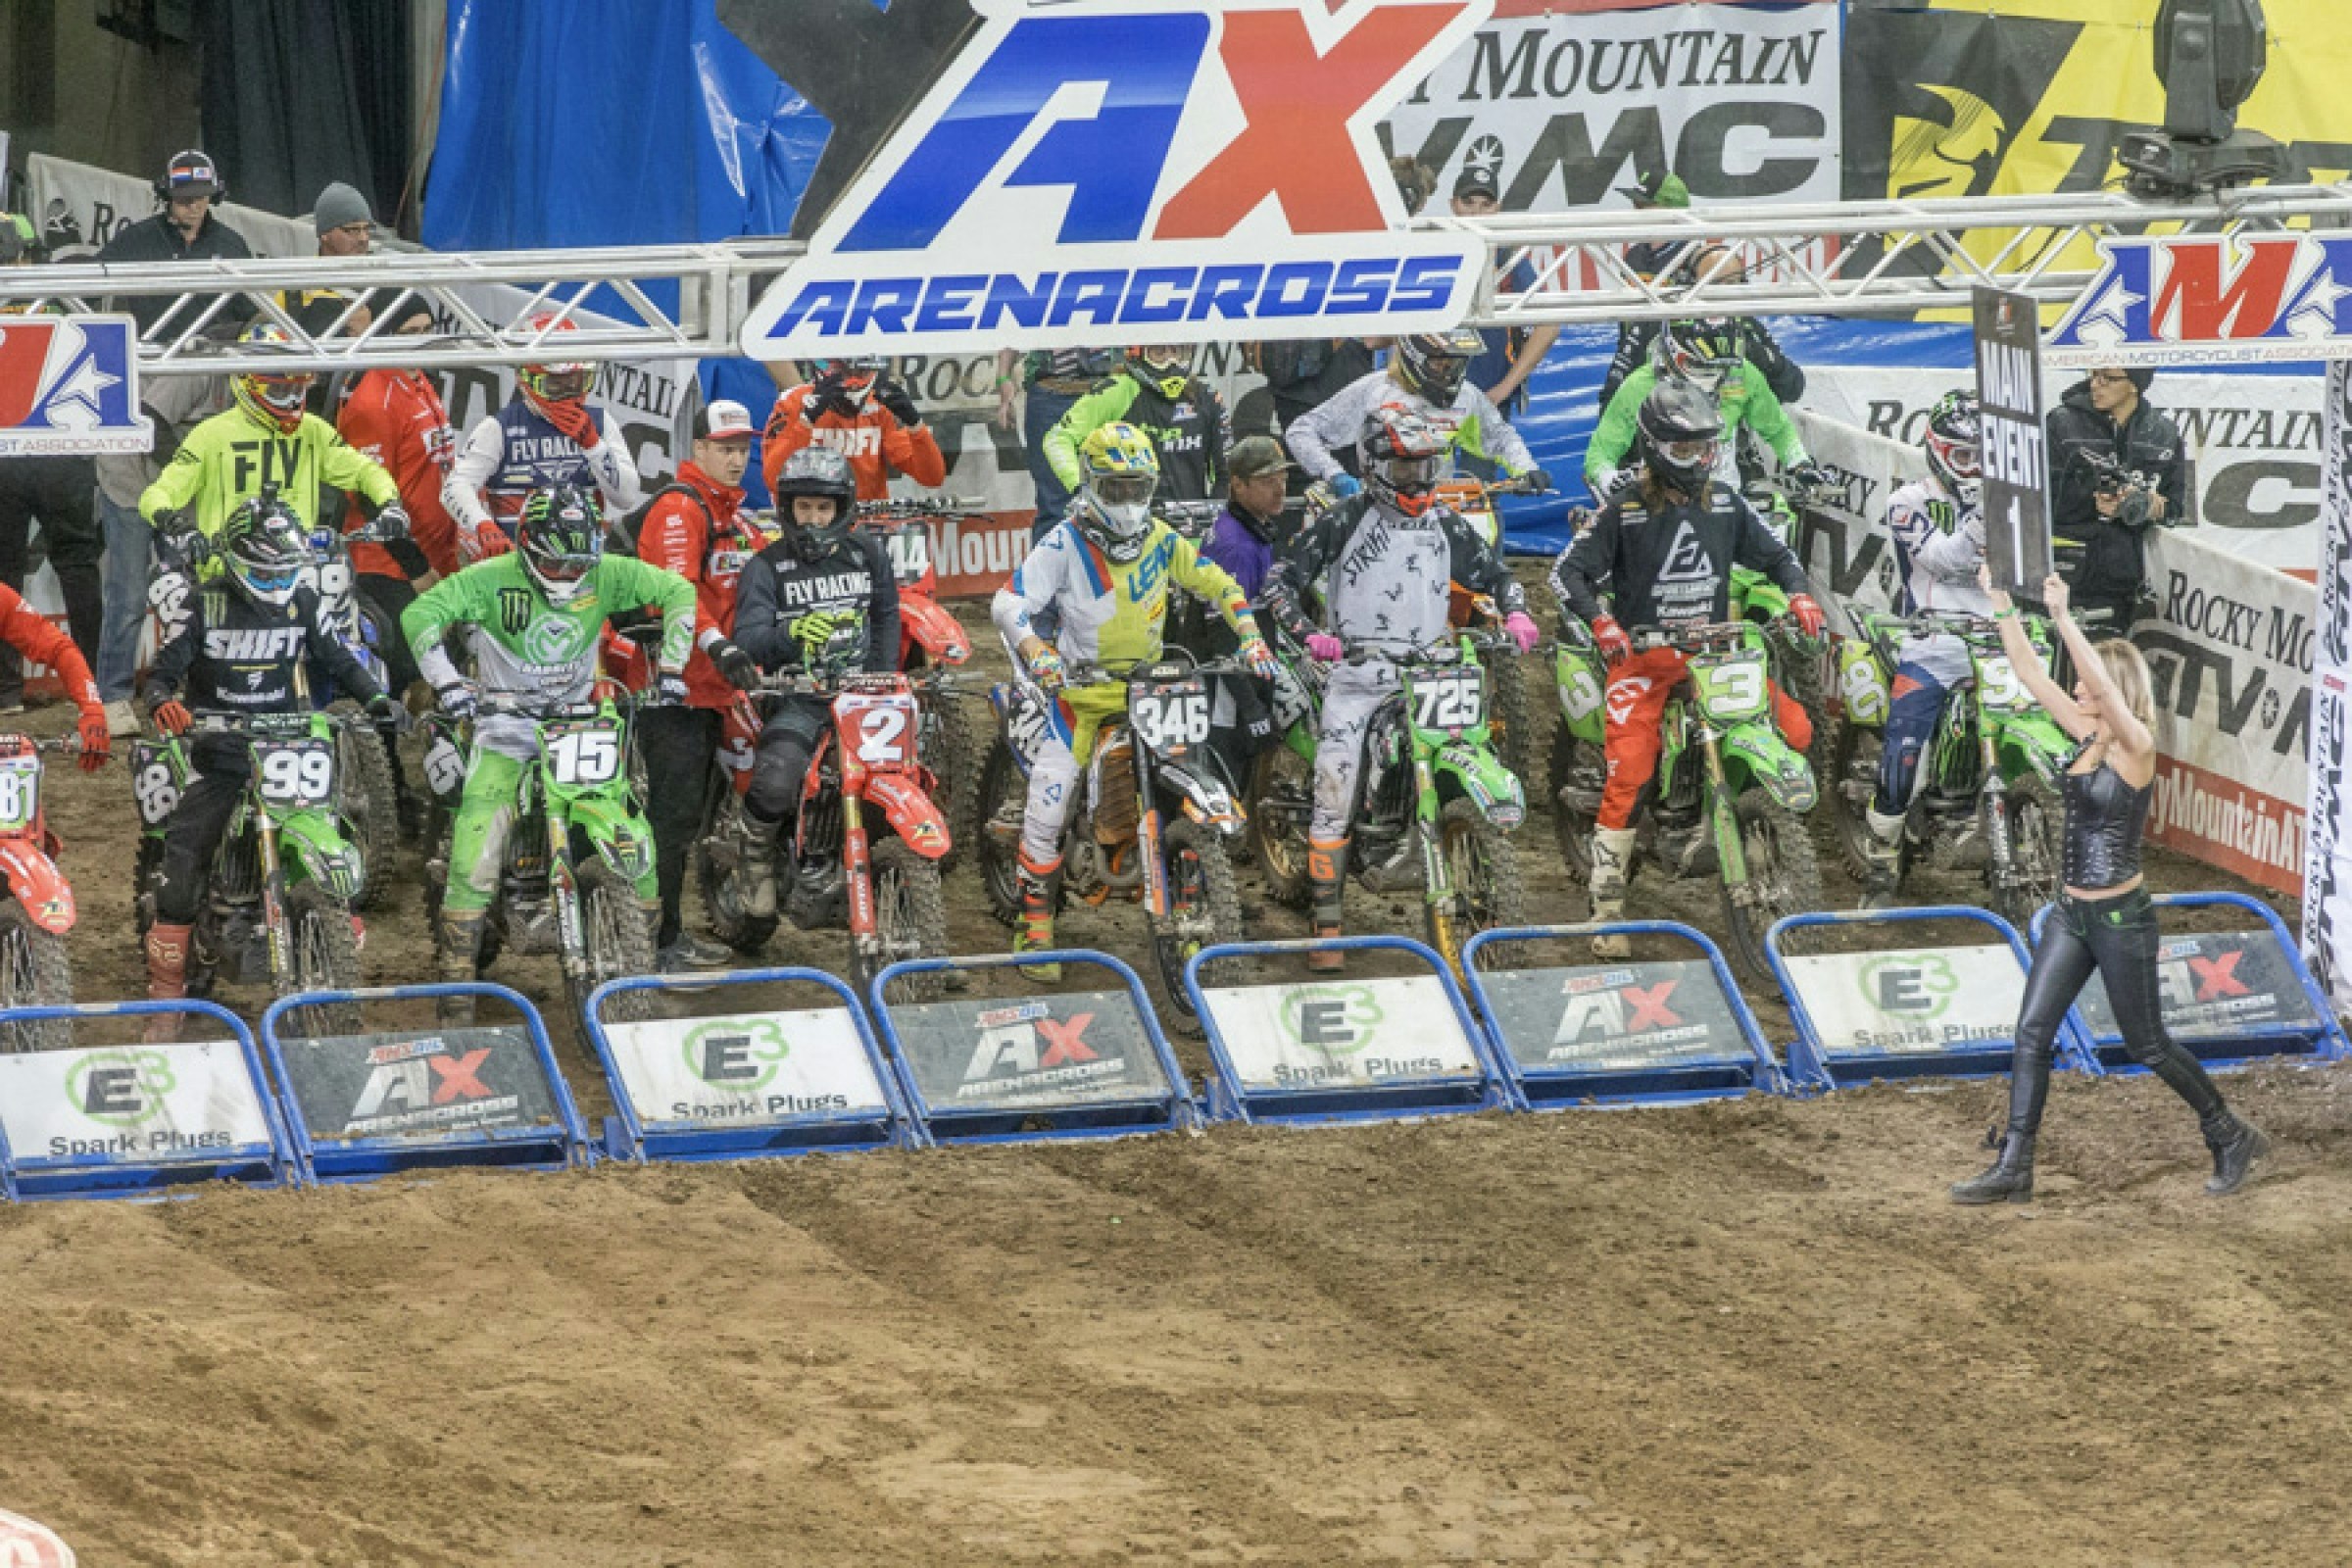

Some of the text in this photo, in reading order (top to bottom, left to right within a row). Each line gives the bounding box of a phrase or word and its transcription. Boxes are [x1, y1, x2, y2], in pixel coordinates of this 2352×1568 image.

[1458, 28, 1827, 101] MOUNTAIN
[833, 2, 1476, 253] AX
[765, 254, 1463, 340] ARENACROSS
[1981, 339, 2034, 415] MAIN
[230, 438, 302, 491] FLY
[1983, 414, 2040, 490] EVENT
[2006, 496, 2025, 586] 1
[785, 580, 813, 606] FLY
[2164, 568, 2263, 652] ROCKY
[203, 628, 306, 660] SHIFT
[1413, 681, 1481, 727] 725
[1709, 662, 1762, 713] 3
[858, 709, 906, 762] 2
[1135, 696, 1209, 747] 346
[261, 751, 331, 798] 99
[547, 731, 619, 783] 15
[1554, 980, 1683, 1043] AX
[964, 1012, 1098, 1079] AX
[352, 1048, 492, 1116] AX
